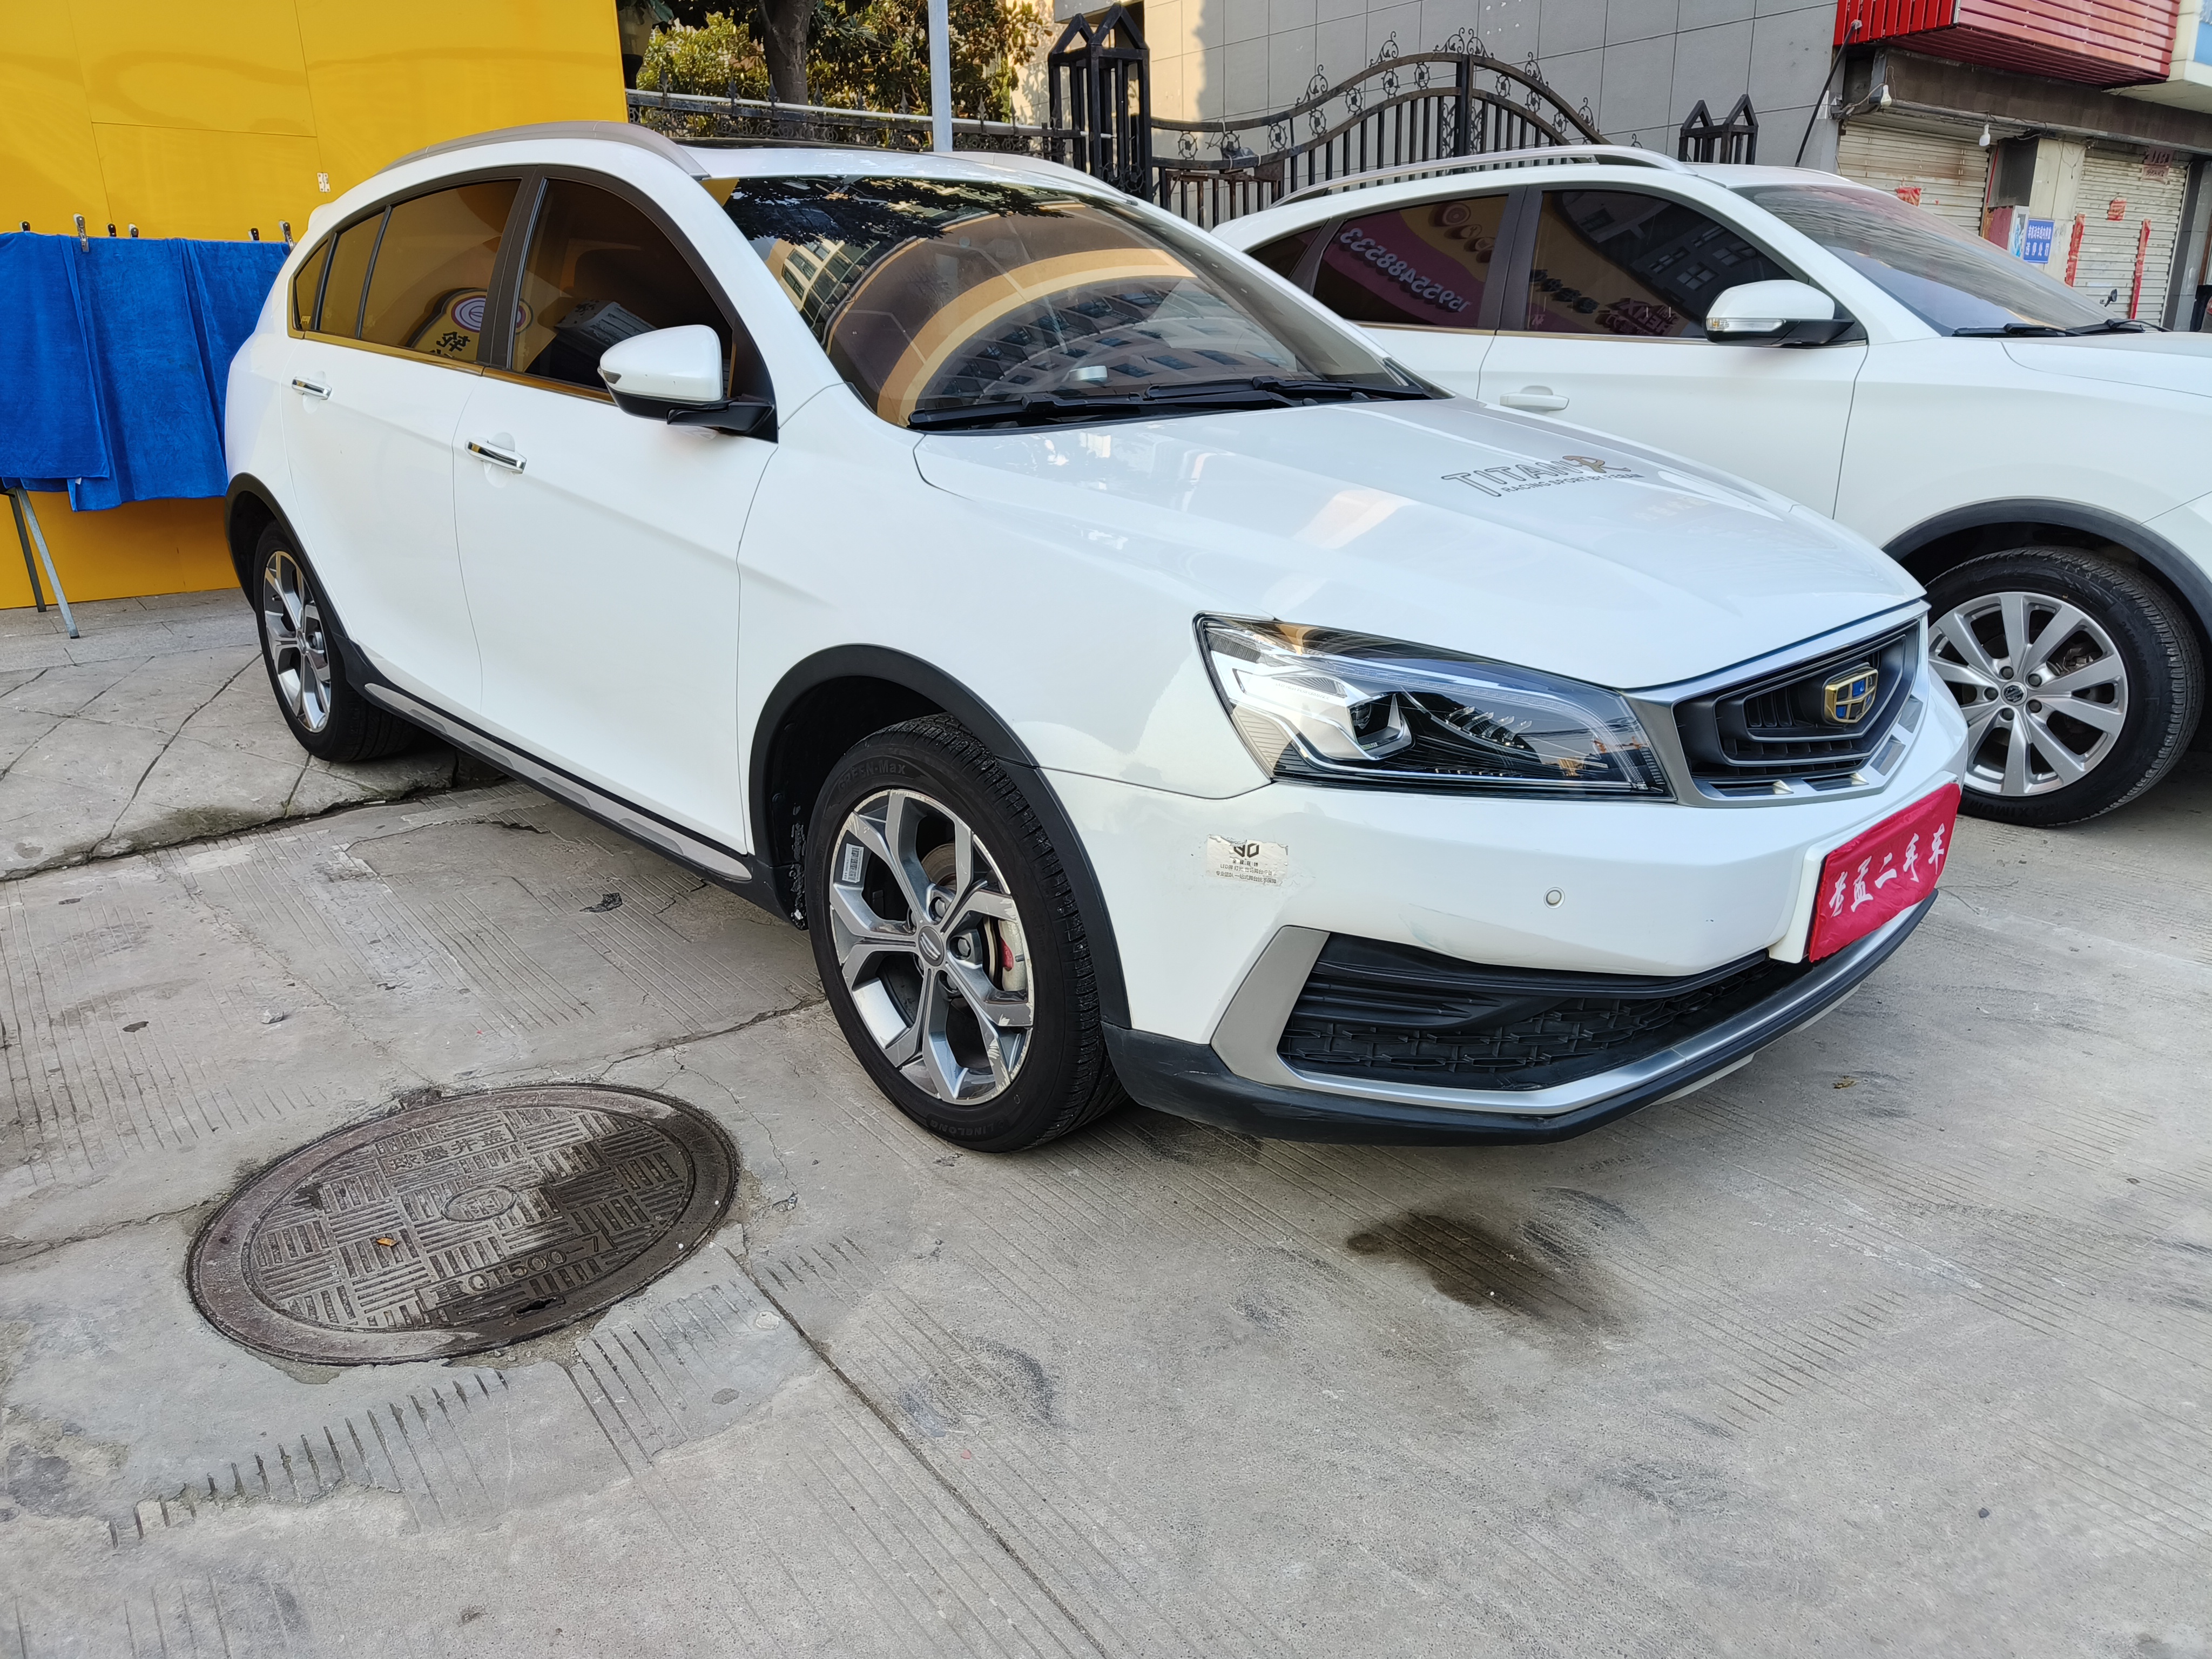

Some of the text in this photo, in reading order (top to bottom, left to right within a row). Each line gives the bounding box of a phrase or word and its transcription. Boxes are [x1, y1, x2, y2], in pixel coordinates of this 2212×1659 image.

[1501, 480, 1551, 493] RACING
[1551, 475, 1589, 485] SPORT
[838, 759, 906, 794] GREEN-Max
[929, 1119, 994, 1137] LINGLONG
